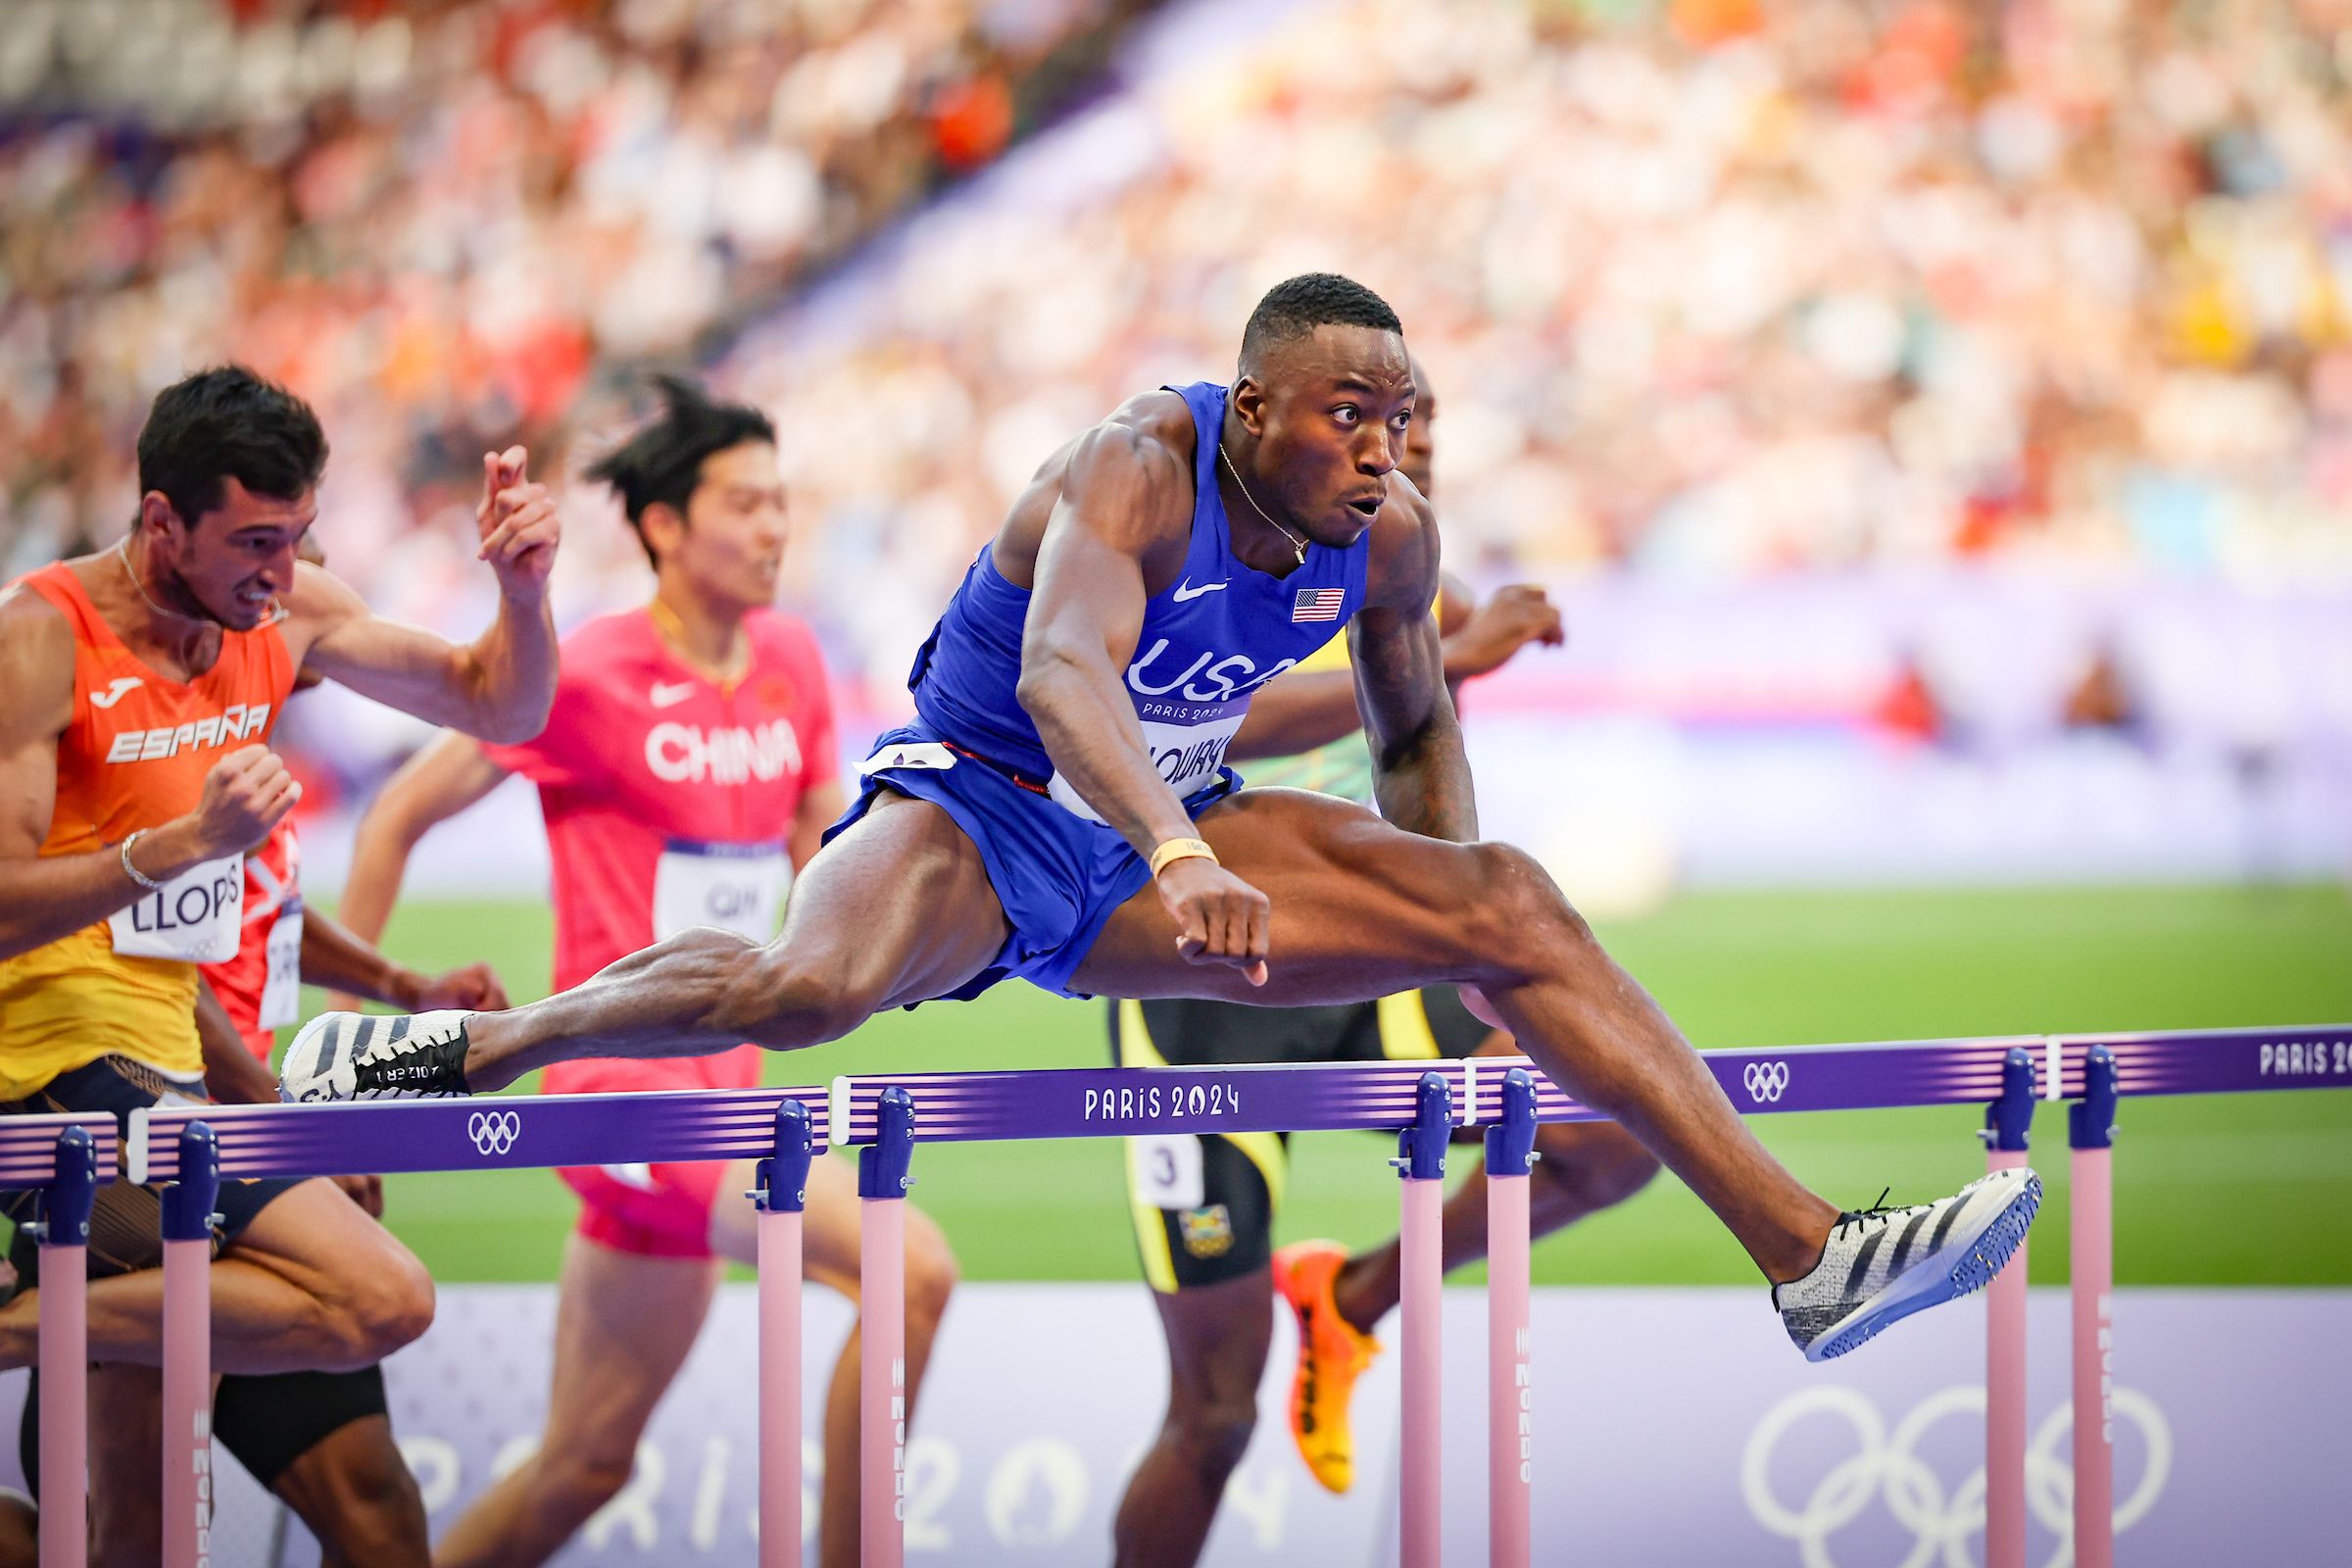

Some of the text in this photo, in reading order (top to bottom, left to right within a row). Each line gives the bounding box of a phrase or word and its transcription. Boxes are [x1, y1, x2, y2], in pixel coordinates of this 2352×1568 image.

[106, 703, 271, 763] ESPAÑA
[644, 718, 804, 785] CHINA
[1150, 735, 1231, 785] OWAY
[1171, 1083, 1239, 1117] 2024
[905, 1434, 1292, 1552] 204
